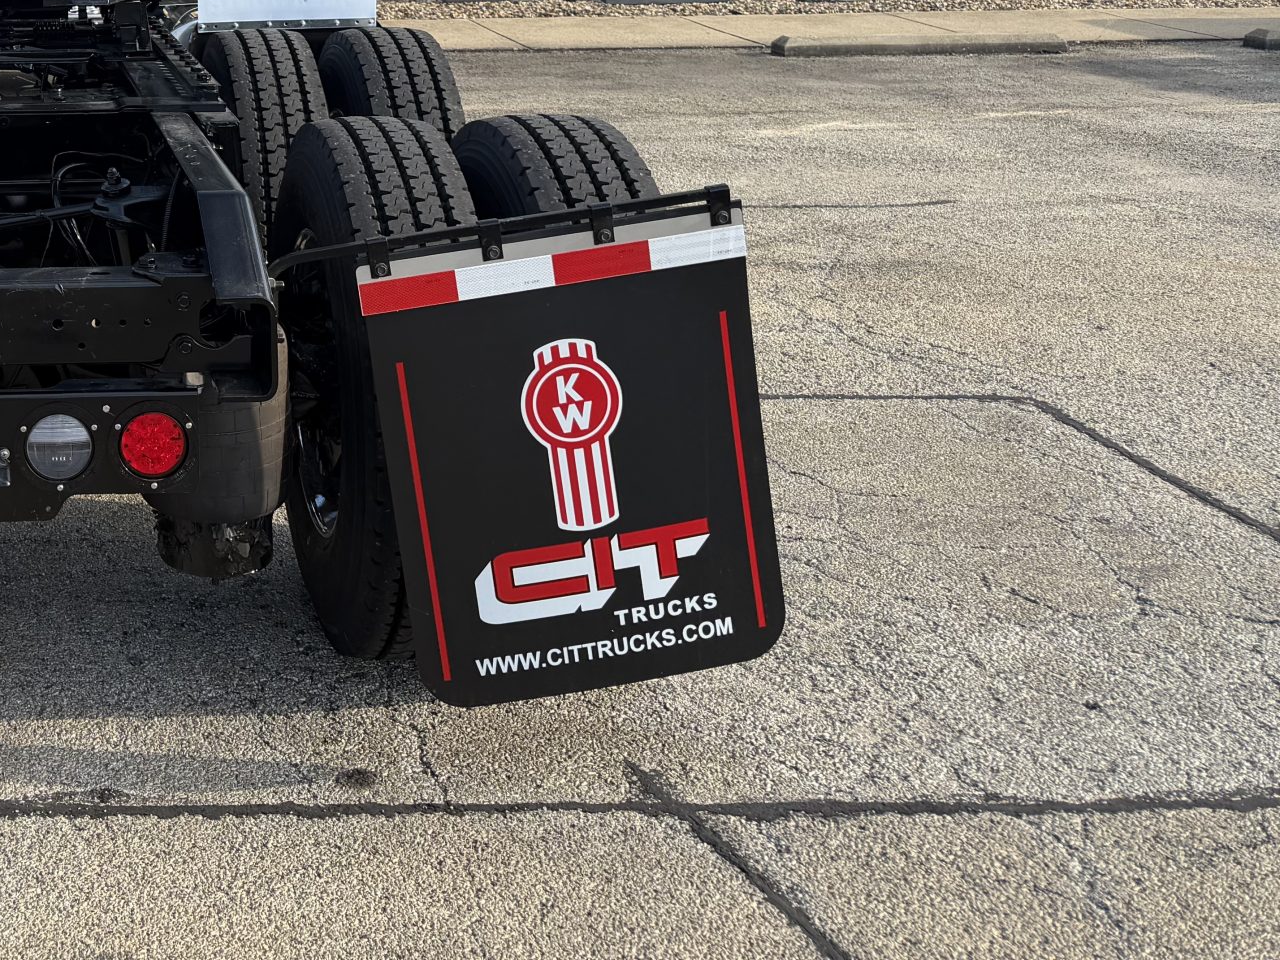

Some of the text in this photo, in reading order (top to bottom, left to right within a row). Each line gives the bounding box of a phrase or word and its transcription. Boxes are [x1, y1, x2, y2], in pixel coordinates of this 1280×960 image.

[474, 517, 710, 625] CIT
[614, 592, 718, 626] TRUCKS
[475, 616, 734, 677] WWW.CITTRUCKS.COM
